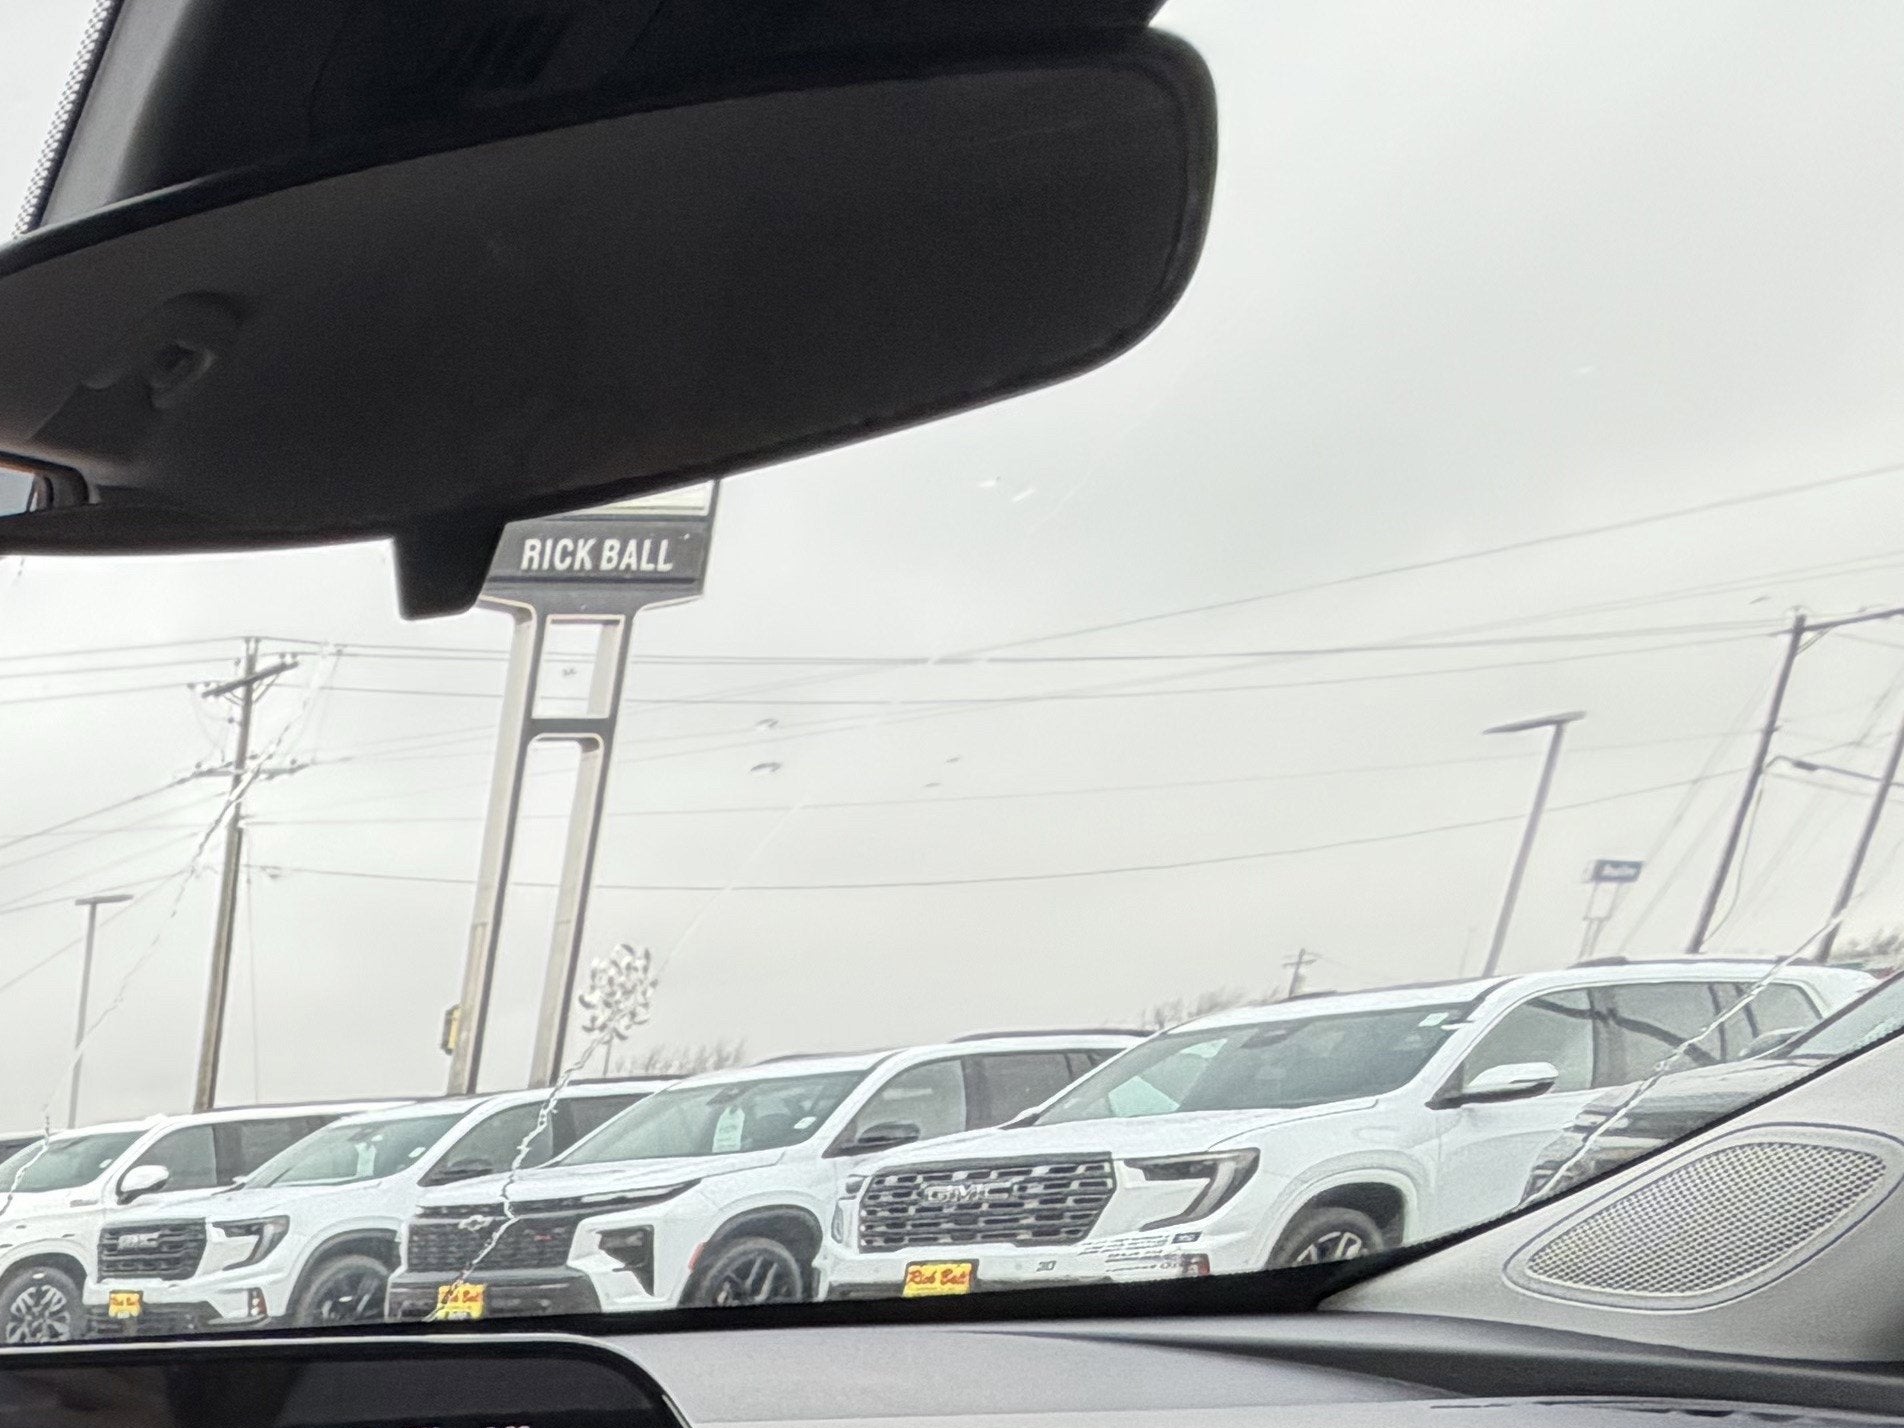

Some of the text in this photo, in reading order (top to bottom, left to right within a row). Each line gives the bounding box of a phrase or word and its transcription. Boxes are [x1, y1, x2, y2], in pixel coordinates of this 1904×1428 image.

[521, 537, 674, 572] RICK BALL
[925, 1182, 1012, 1203] GMC
